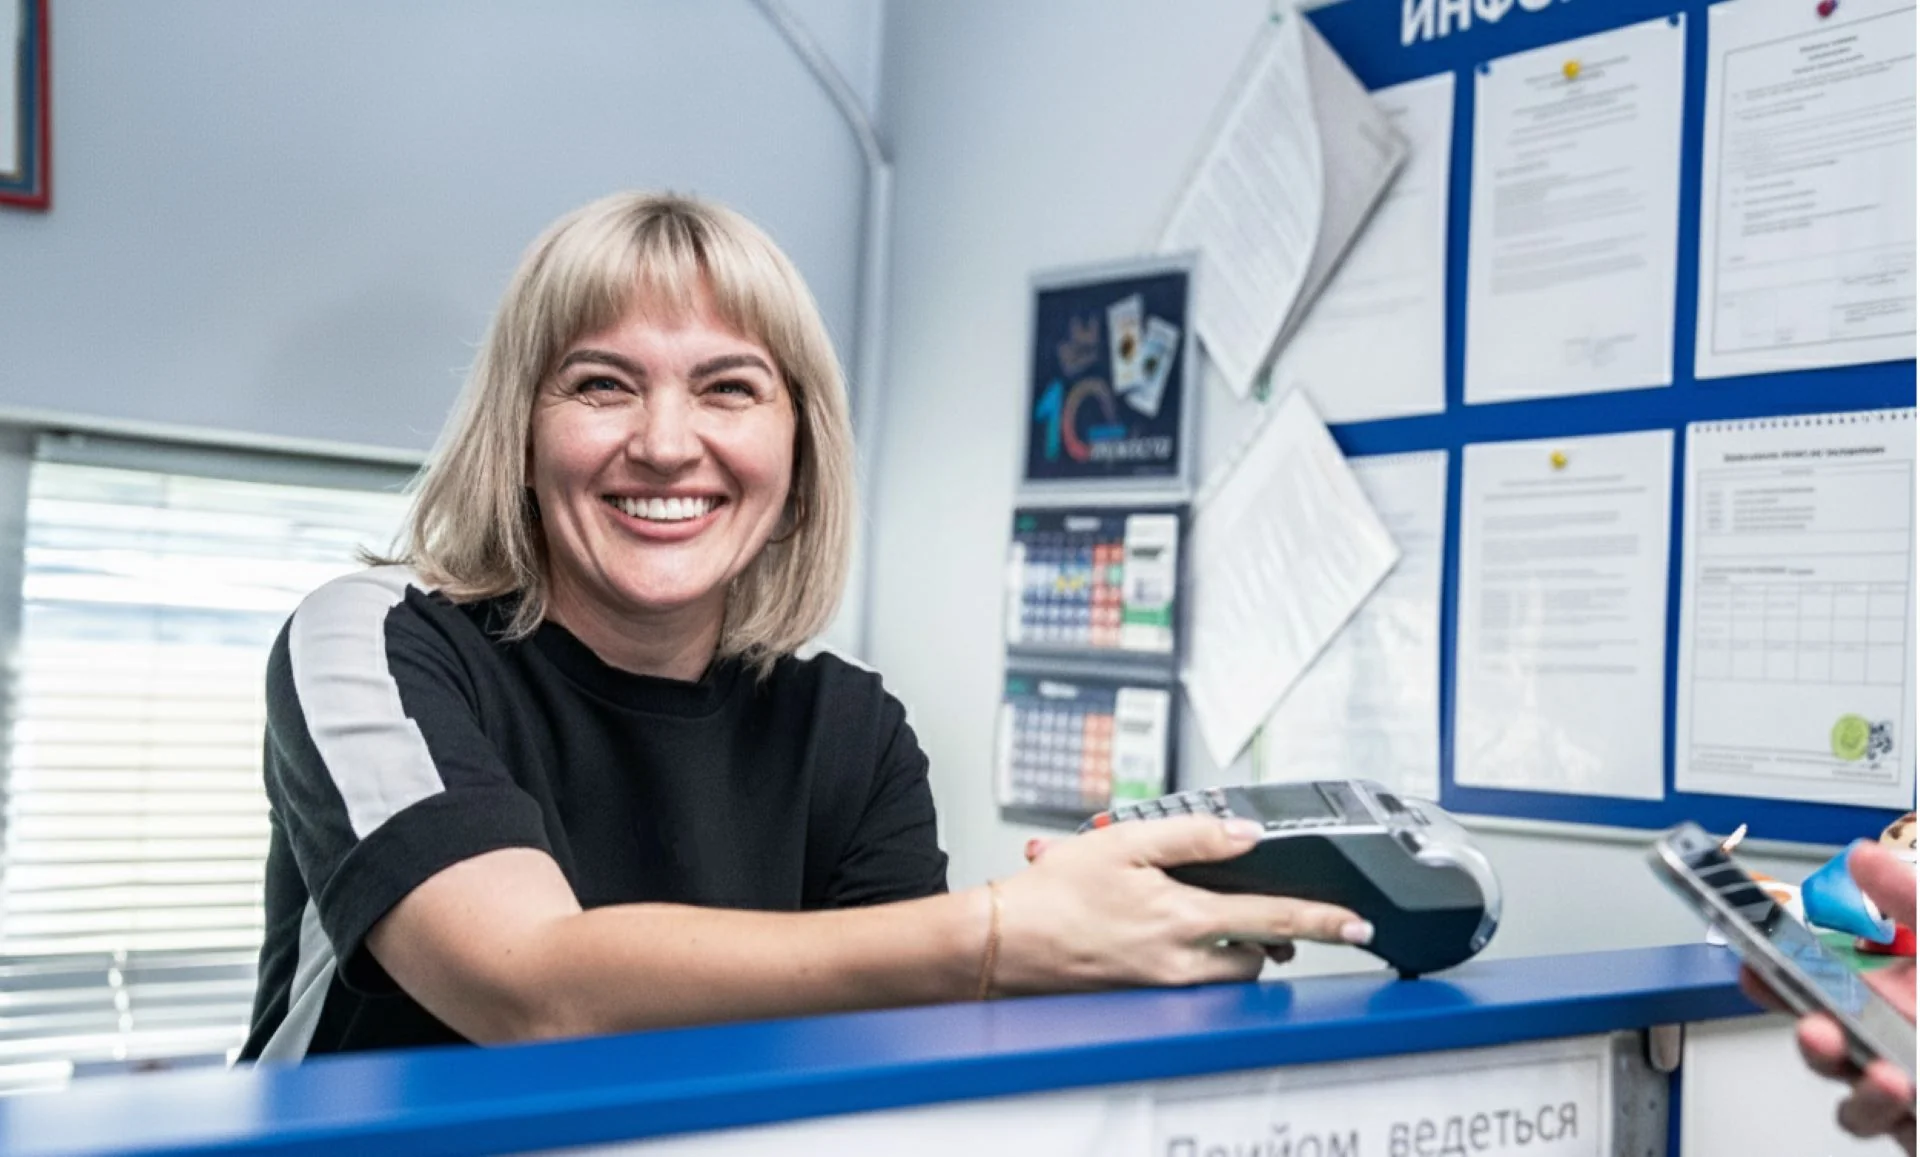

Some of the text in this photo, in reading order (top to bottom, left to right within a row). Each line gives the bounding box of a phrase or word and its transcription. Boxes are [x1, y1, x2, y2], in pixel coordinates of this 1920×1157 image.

[1401, 0, 1570, 46] ИНФ
[1166, 1101, 1577, 1157] Пийом ведеться
